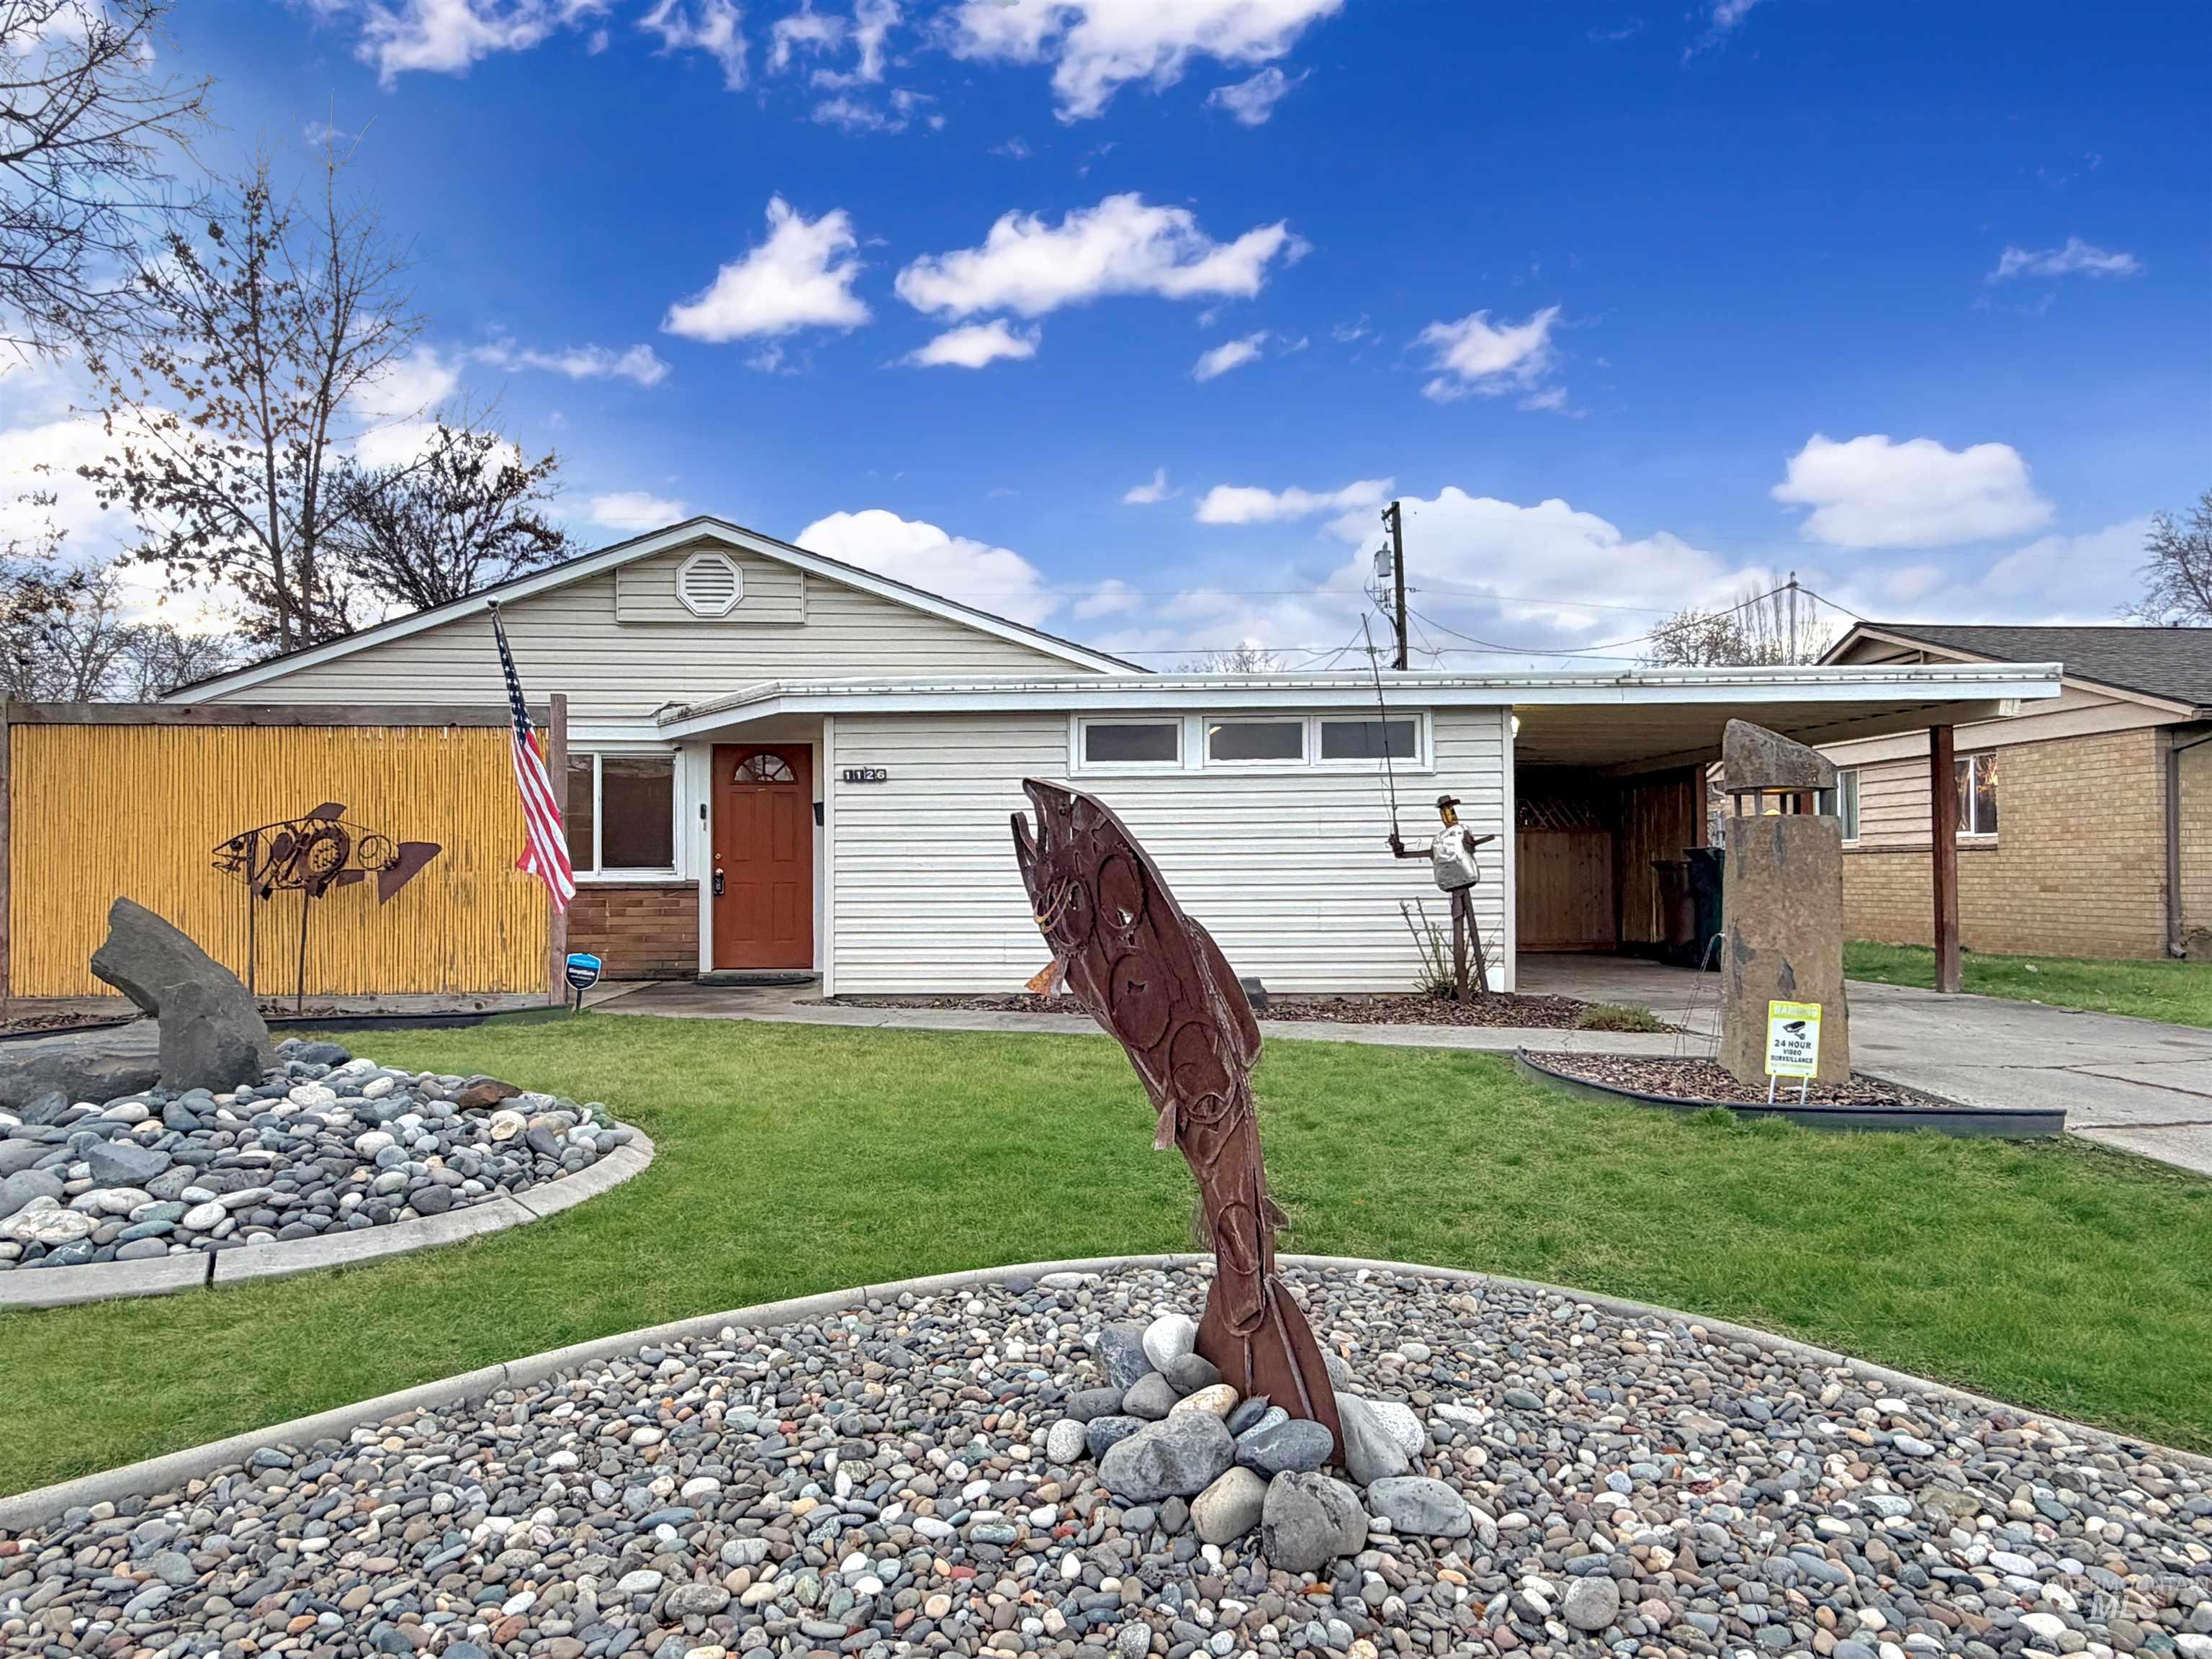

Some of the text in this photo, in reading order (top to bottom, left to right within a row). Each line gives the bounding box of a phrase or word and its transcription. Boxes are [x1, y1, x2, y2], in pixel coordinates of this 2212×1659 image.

[845, 770, 885, 780] 1126
[1788, 1040, 1812, 1049] HOUR
[1771, 1055, 1814, 1064] SURVEILLANCE
